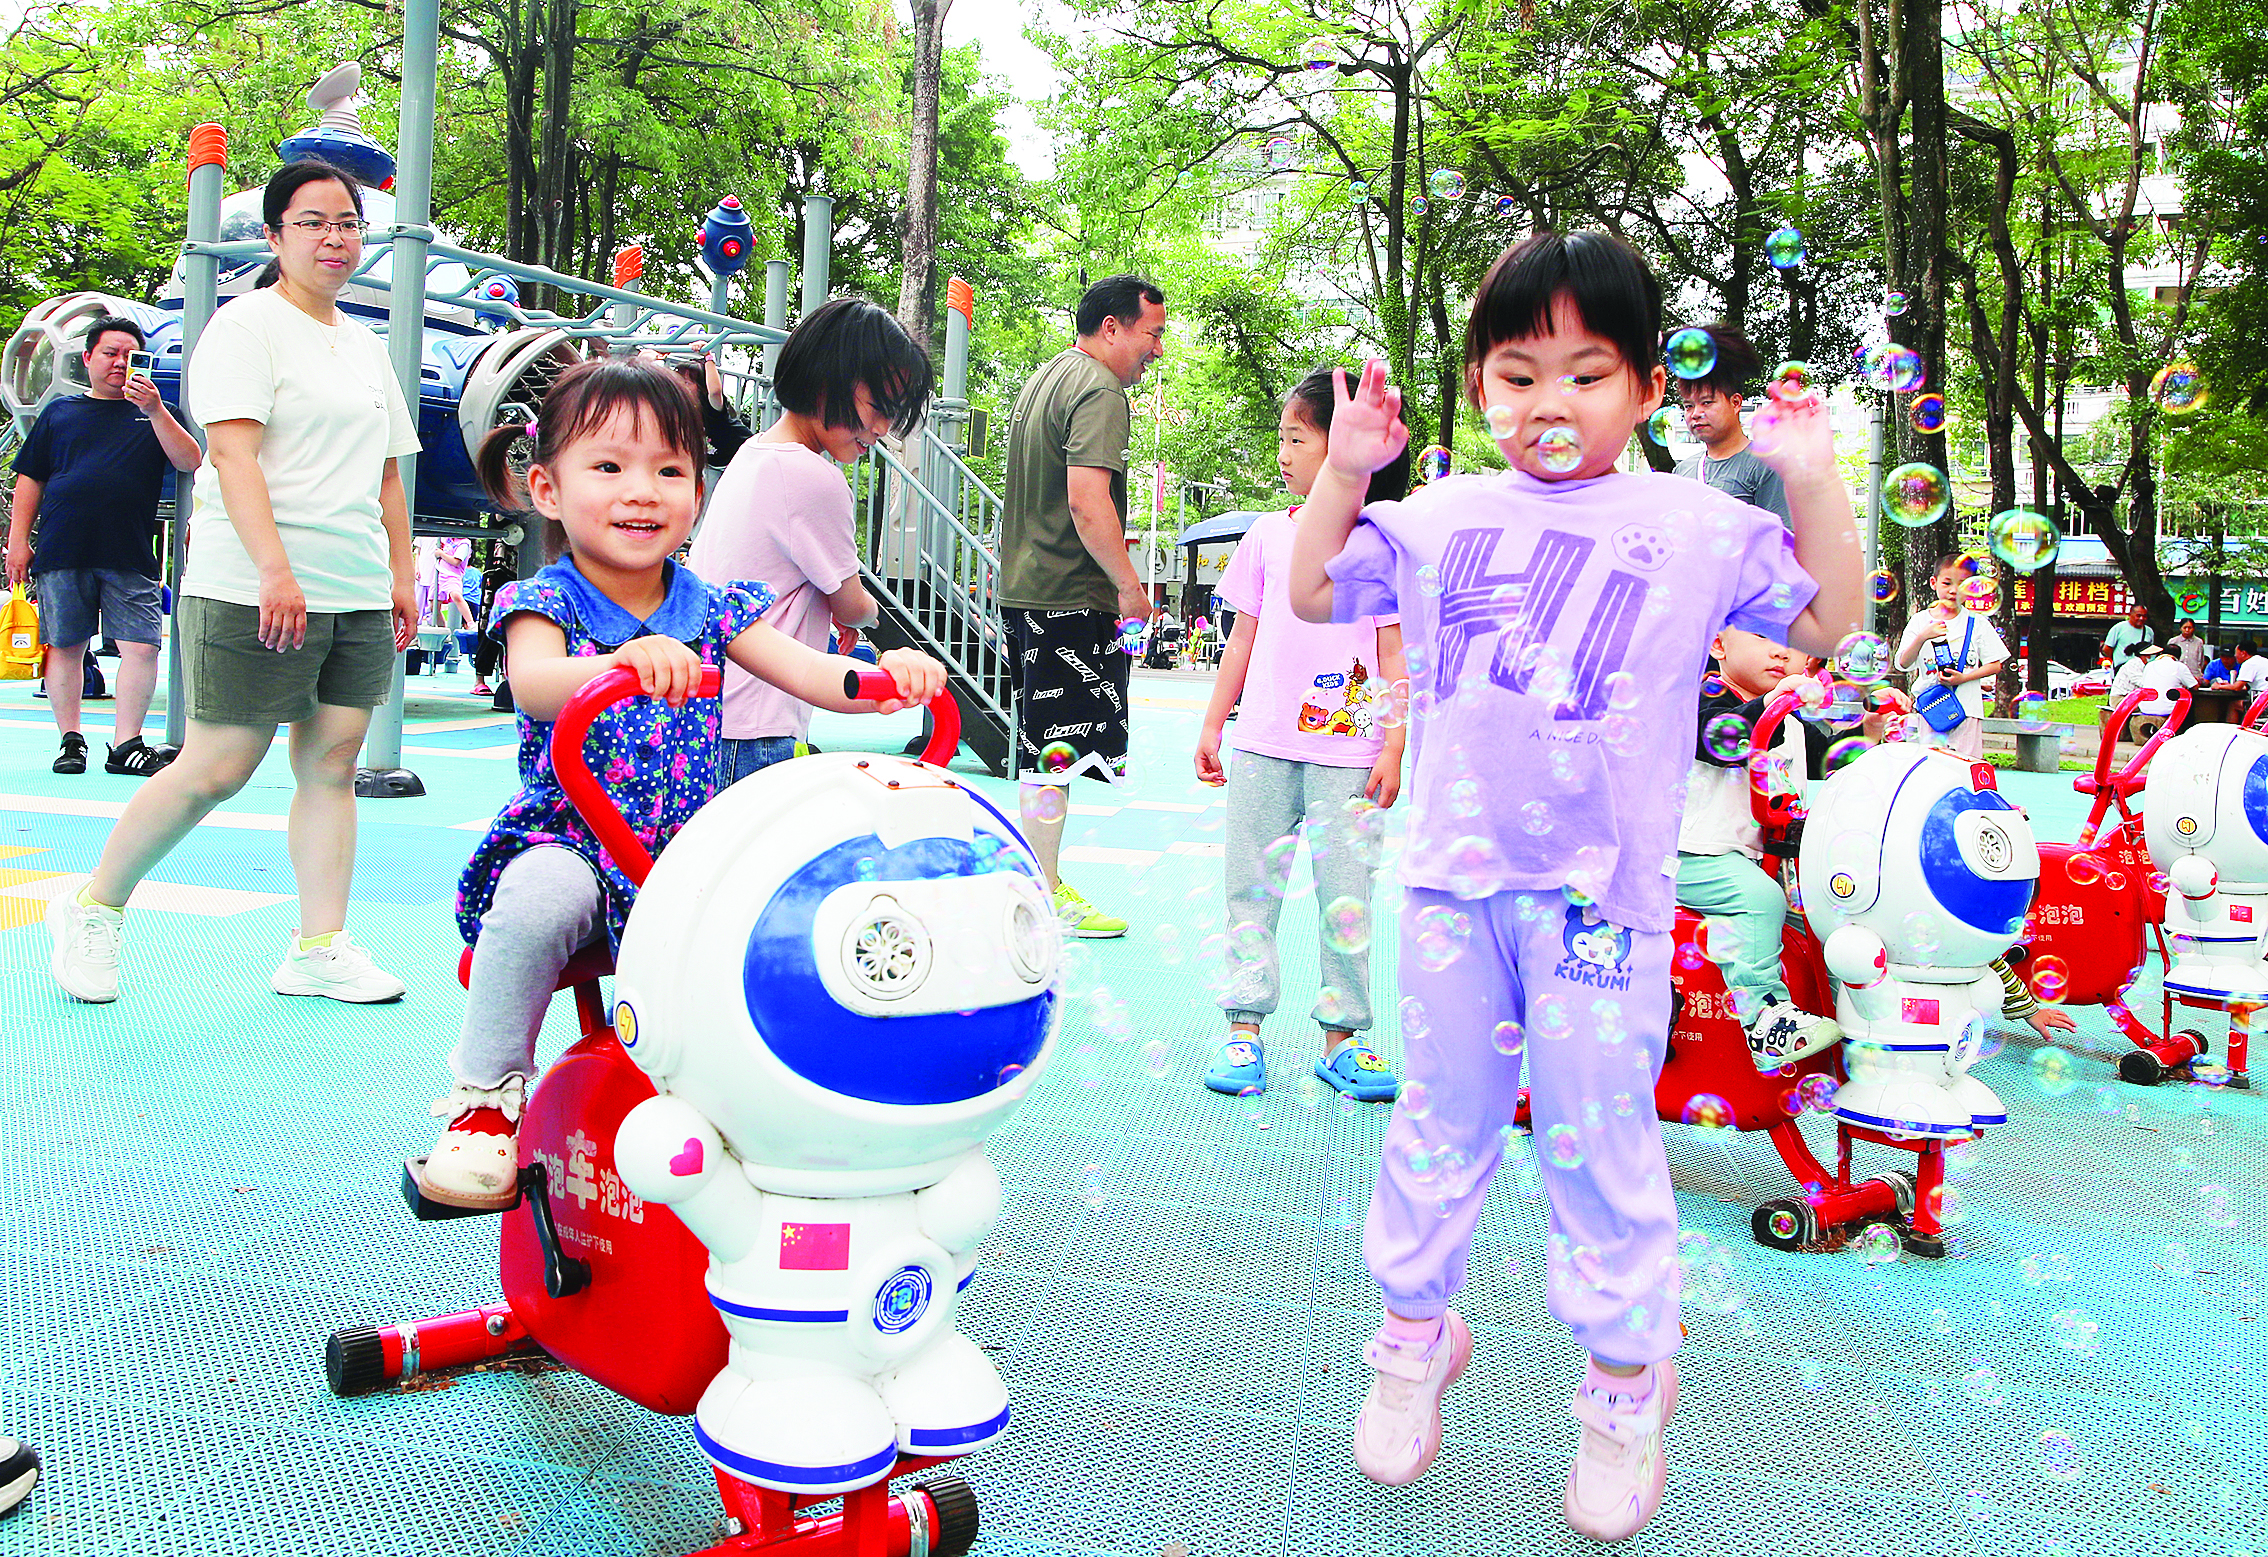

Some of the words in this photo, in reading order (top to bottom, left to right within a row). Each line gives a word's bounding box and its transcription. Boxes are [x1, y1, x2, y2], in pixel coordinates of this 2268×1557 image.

[1435, 527, 1652, 721] Hi
[1528, 729, 1540, 740] A
[1554, 963, 1631, 992] KUKUMI
[554, 1222, 613, 1255] 在成年人监护下使用
